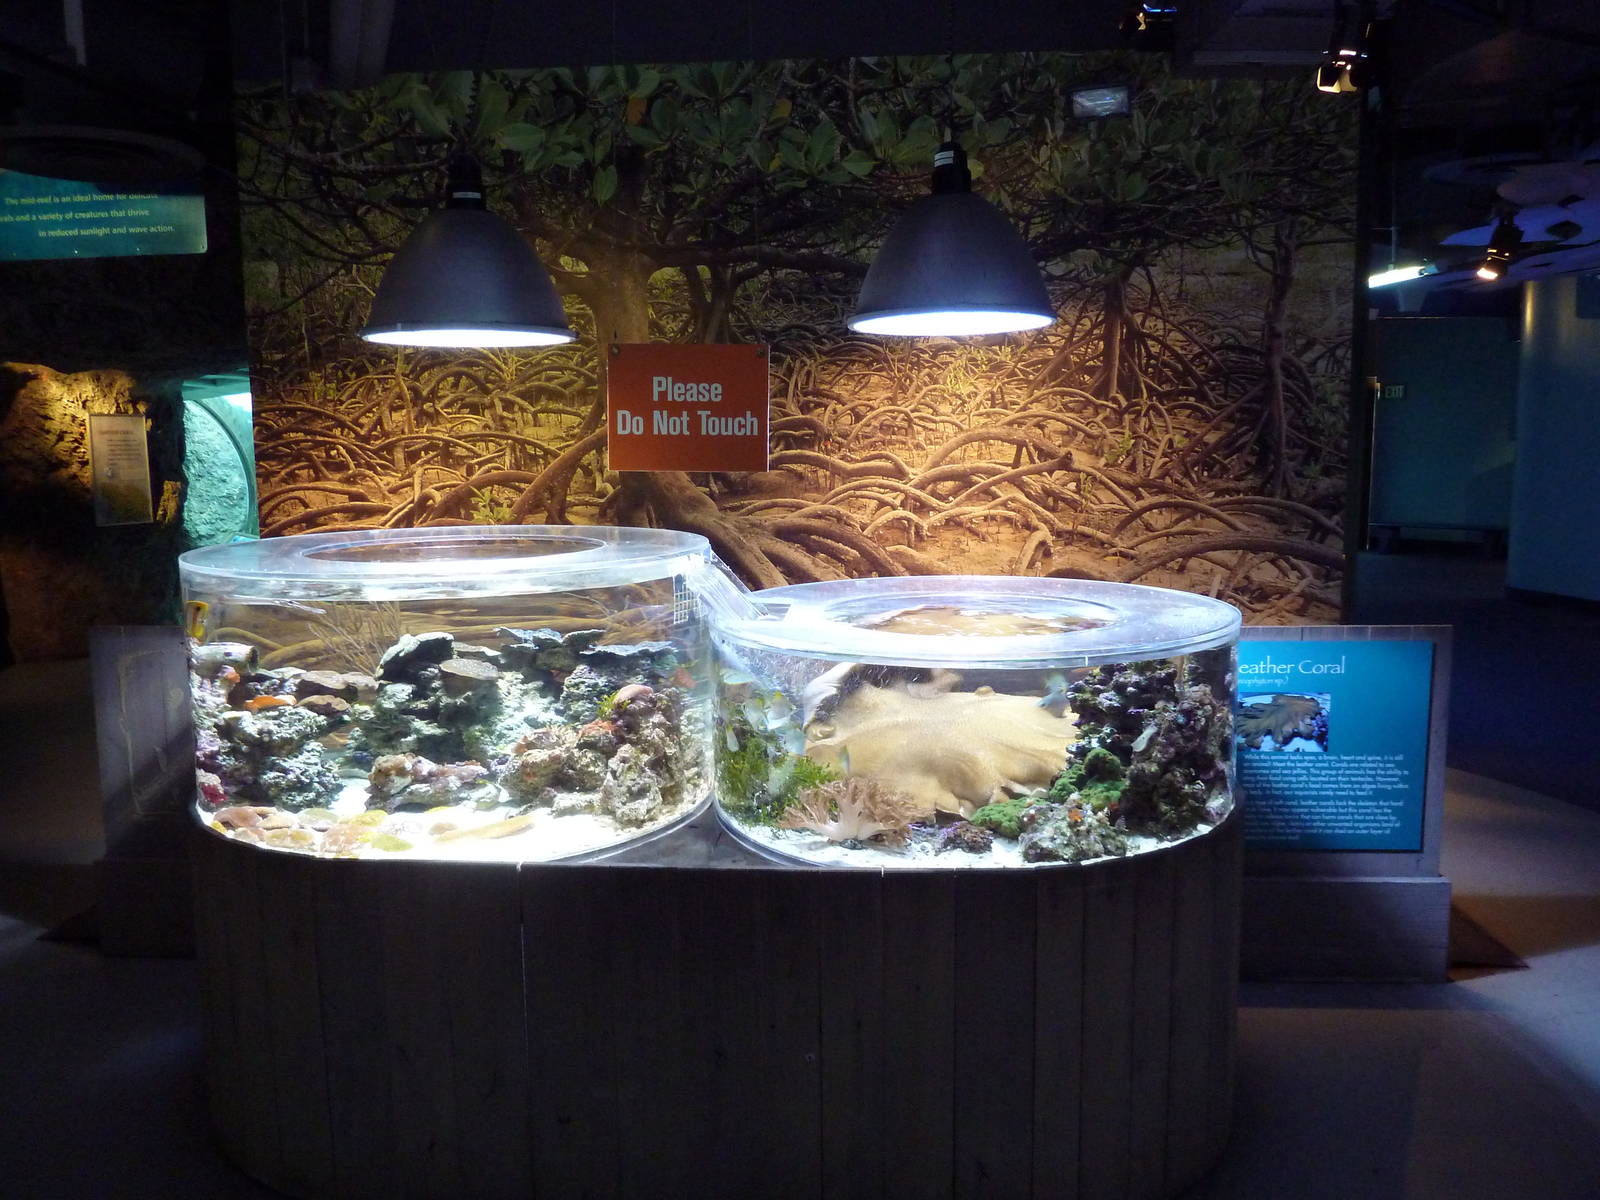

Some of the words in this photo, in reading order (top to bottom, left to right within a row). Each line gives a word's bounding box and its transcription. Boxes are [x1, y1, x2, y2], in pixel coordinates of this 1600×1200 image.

[53, 194, 60, 203] is
[73, 194, 91, 202] ideal
[38, 211, 63, 221] variety
[65, 210, 74, 219] of
[75, 209, 108, 219] creatures
[110, 208, 126, 217] that
[127, 208, 150, 217] thrive
[48, 227, 79, 237] reduced
[80, 226, 110, 237] sunlight
[112, 226, 127, 234] and
[128, 226, 149, 234] wave
[149, 224, 176, 233] action.
[652, 376, 722, 402] Please
[1385, 385, 1404, 399] EXIT
[616, 409, 644, 436] Do
[653, 409, 690, 436] Not
[697, 410, 759, 437] Touch
[1238, 655, 1296, 674] eather
[1298, 655, 1346, 674] Coral
